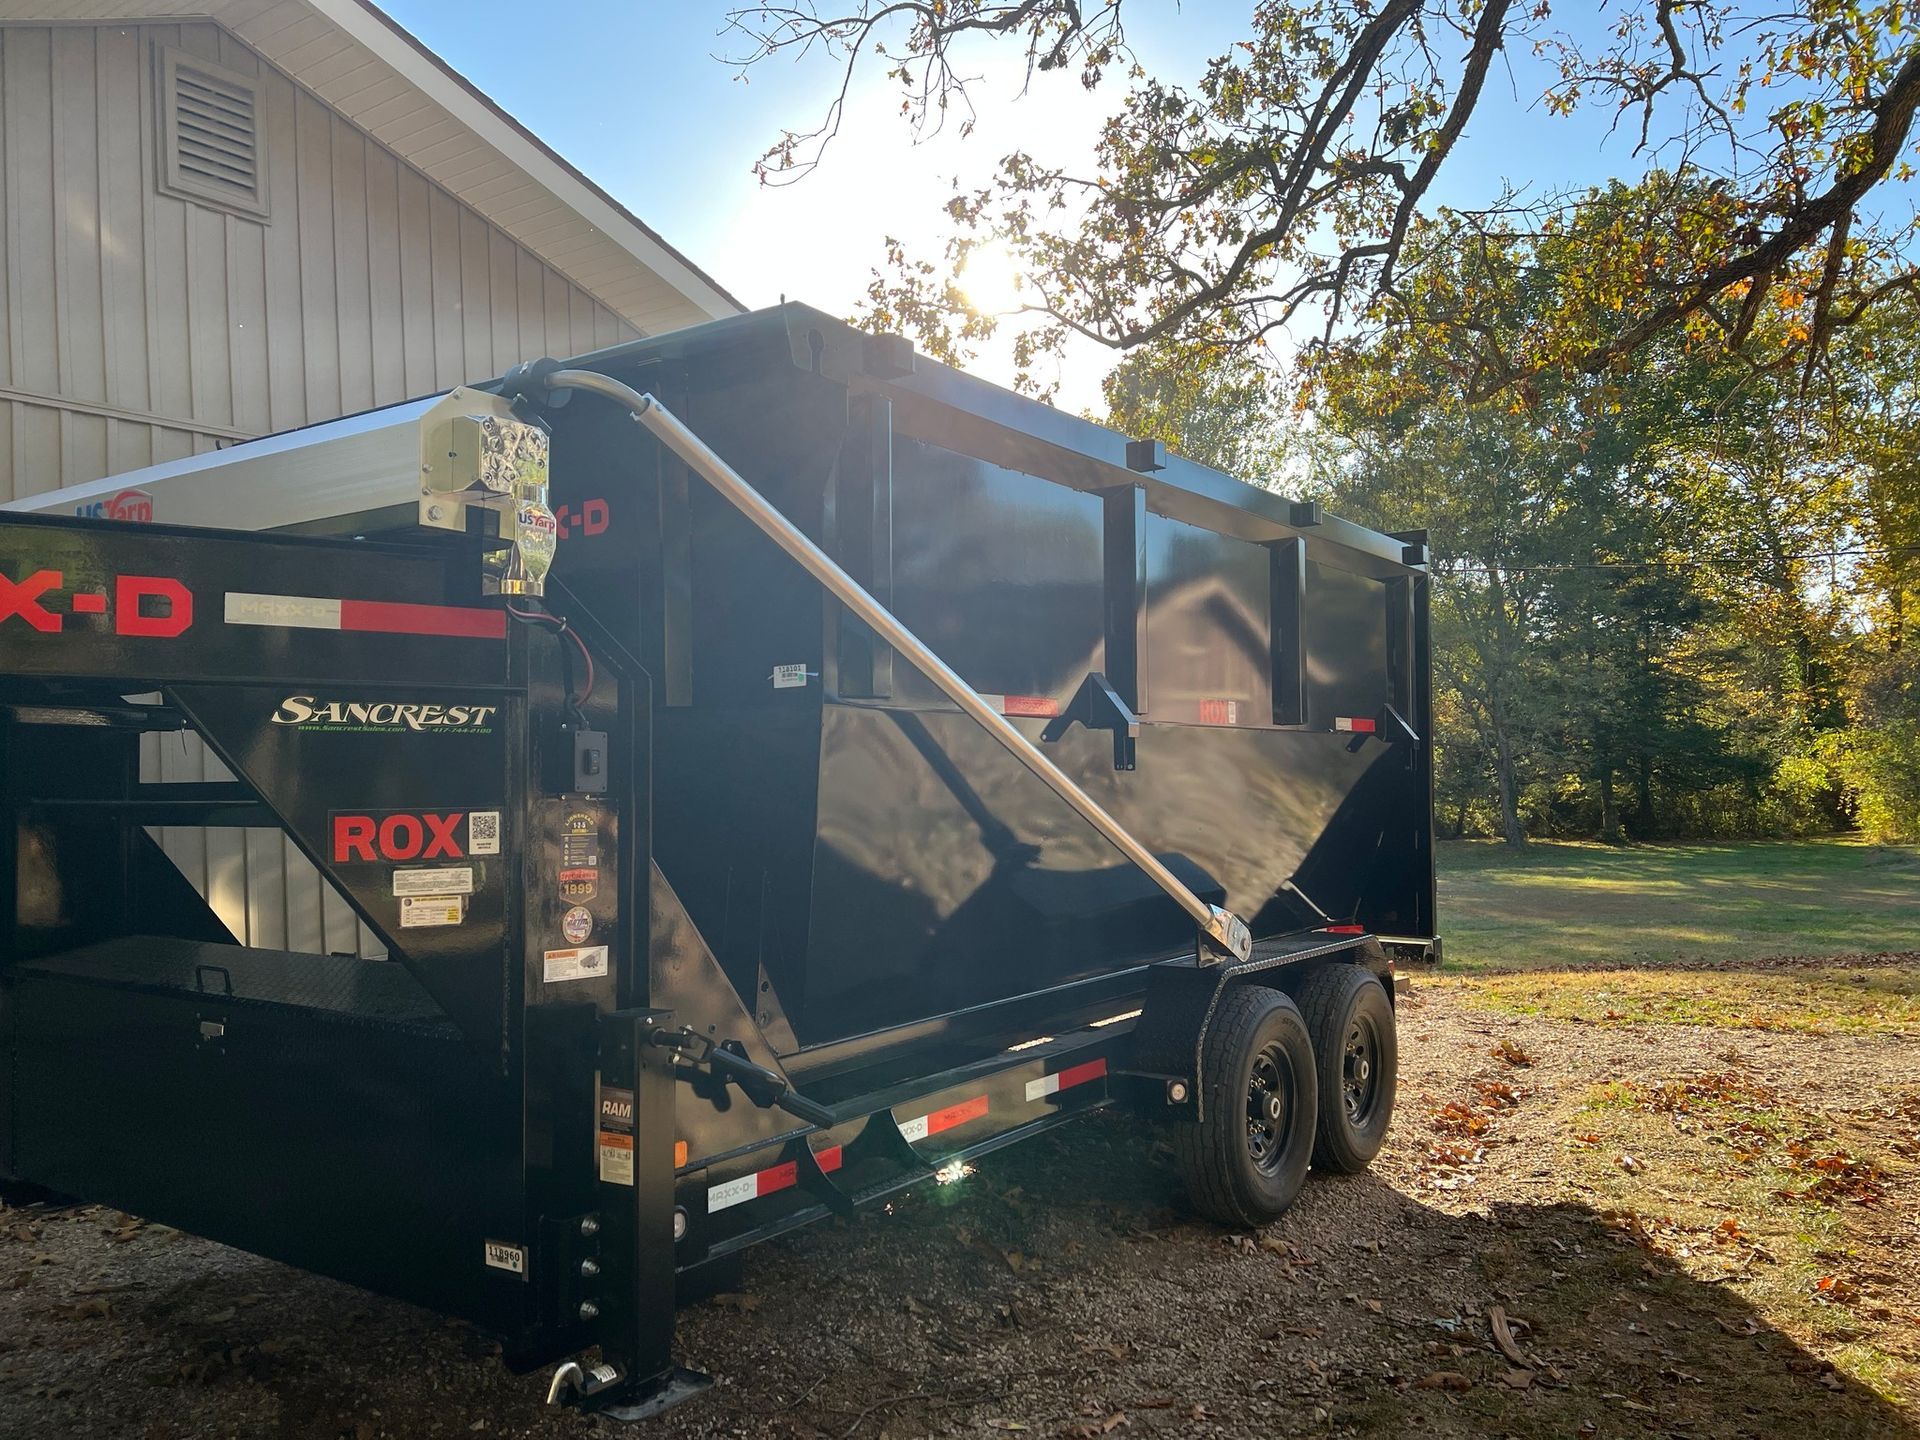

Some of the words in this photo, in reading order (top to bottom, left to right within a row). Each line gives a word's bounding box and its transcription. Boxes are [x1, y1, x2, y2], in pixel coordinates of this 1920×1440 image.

[240, 601, 326, 618] MAXX-D
[334, 813, 464, 862] ROX
[564, 883, 593, 895] 1999
[602, 1100, 631, 1118] RAM
[489, 1246, 520, 1262] 118960
